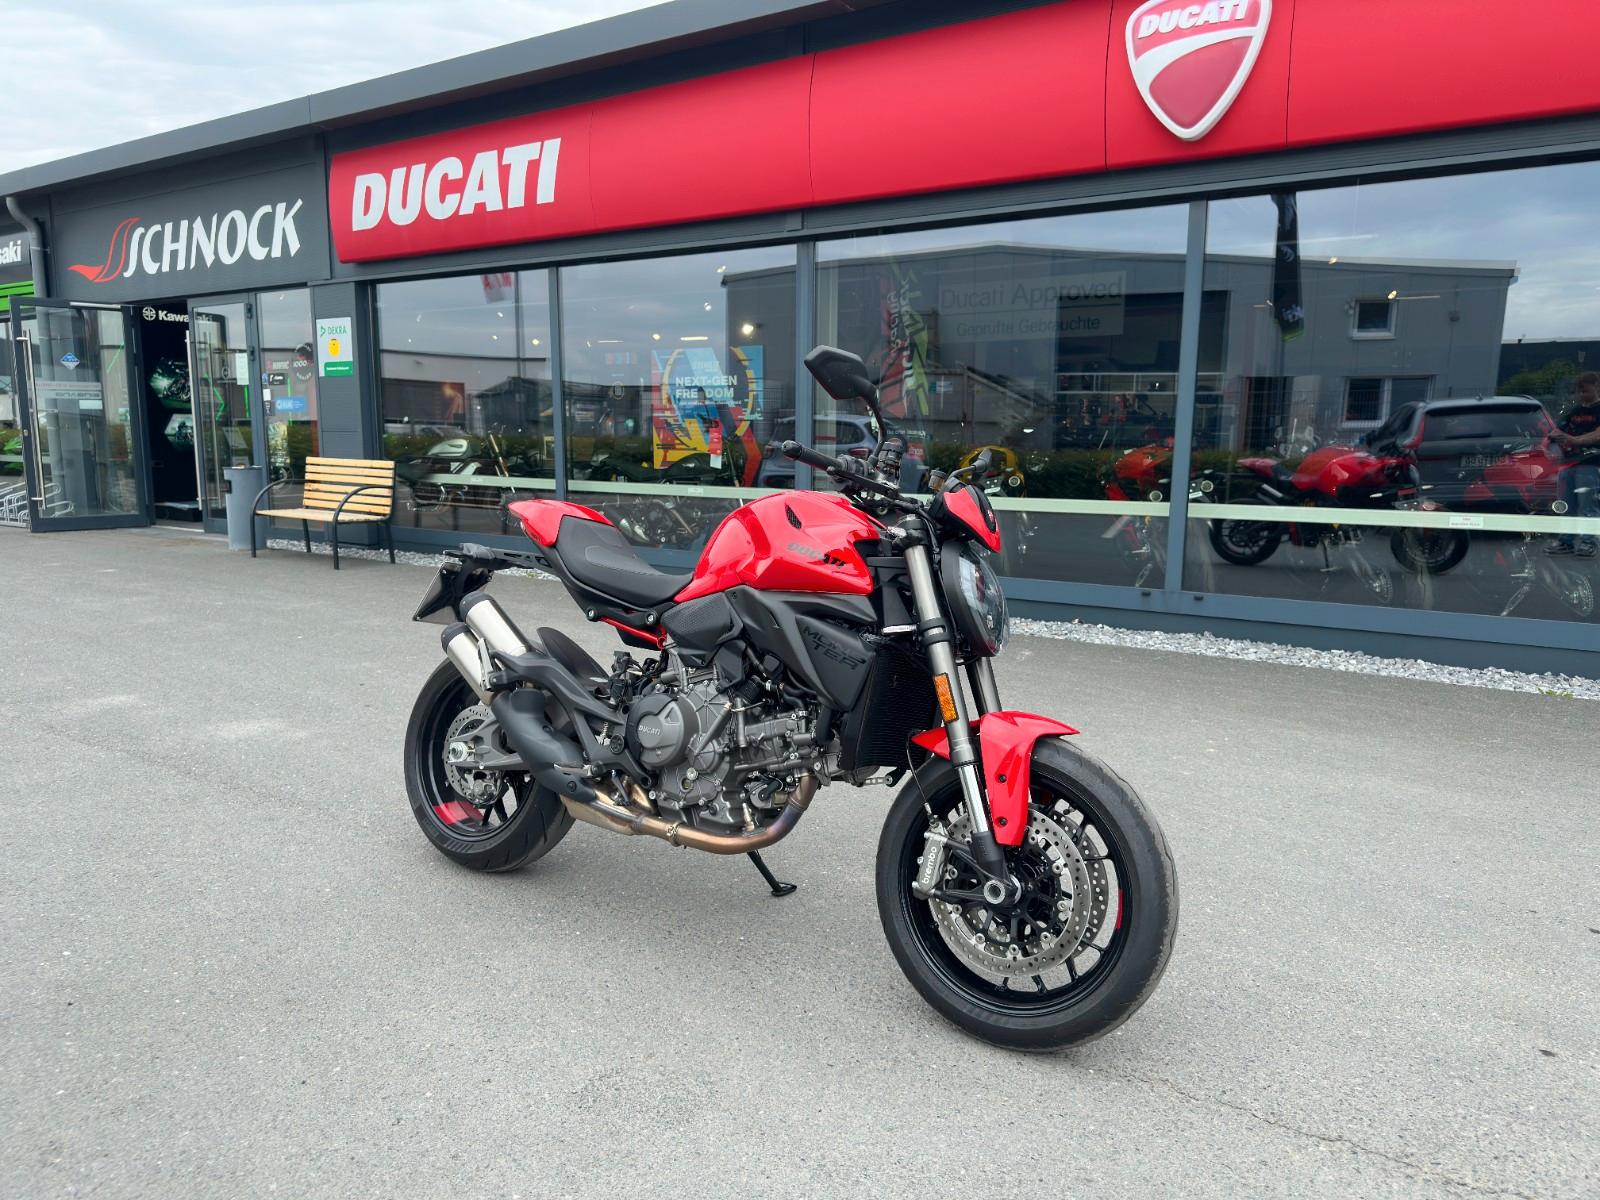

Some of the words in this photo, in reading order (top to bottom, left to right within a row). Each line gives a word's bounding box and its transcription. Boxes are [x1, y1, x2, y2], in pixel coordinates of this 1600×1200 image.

[1138, 0, 1249, 38] DUCATI
[352, 137, 562, 232] DUCATI
[123, 198, 303, 278] SCHNOCK
[0, 240, 21, 264] aki
[941, 285, 1004, 309] Ducati
[1011, 273, 1122, 309] Approved
[327, 325, 347, 335] DEKRA
[1018, 316, 1101, 334] Gebrauchte
[675, 375, 737, 386] NEXT-GEN
[675, 387, 734, 399] FREDOM
[786, 542, 846, 569] DUCATI
[638, 725, 660, 735] DUCATI
[921, 846, 937, 884] brembo
